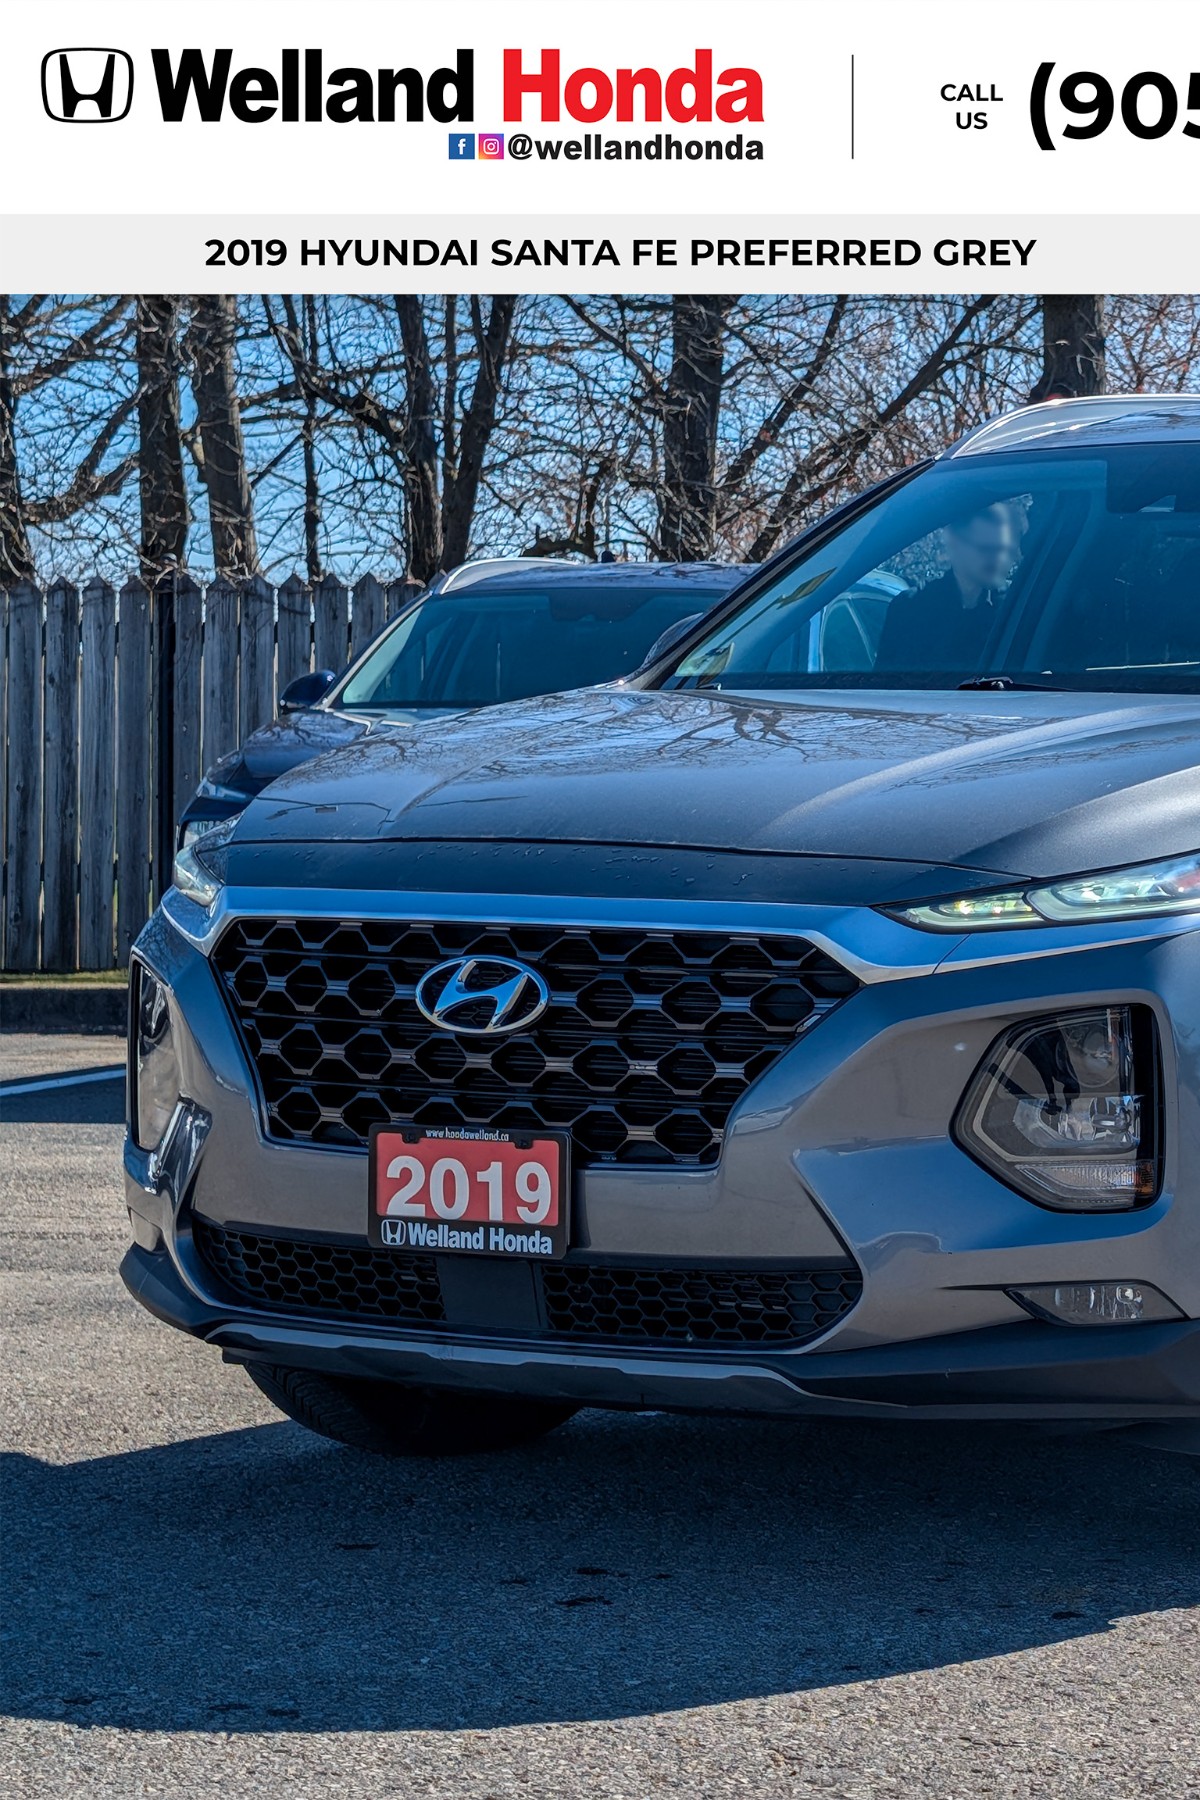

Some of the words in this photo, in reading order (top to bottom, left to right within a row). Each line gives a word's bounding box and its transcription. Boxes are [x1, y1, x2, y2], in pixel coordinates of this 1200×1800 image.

[386, 1155, 551, 1225] 2019
[408, 1222, 484, 1251] Welland
[489, 1227, 553, 1255] Honda
